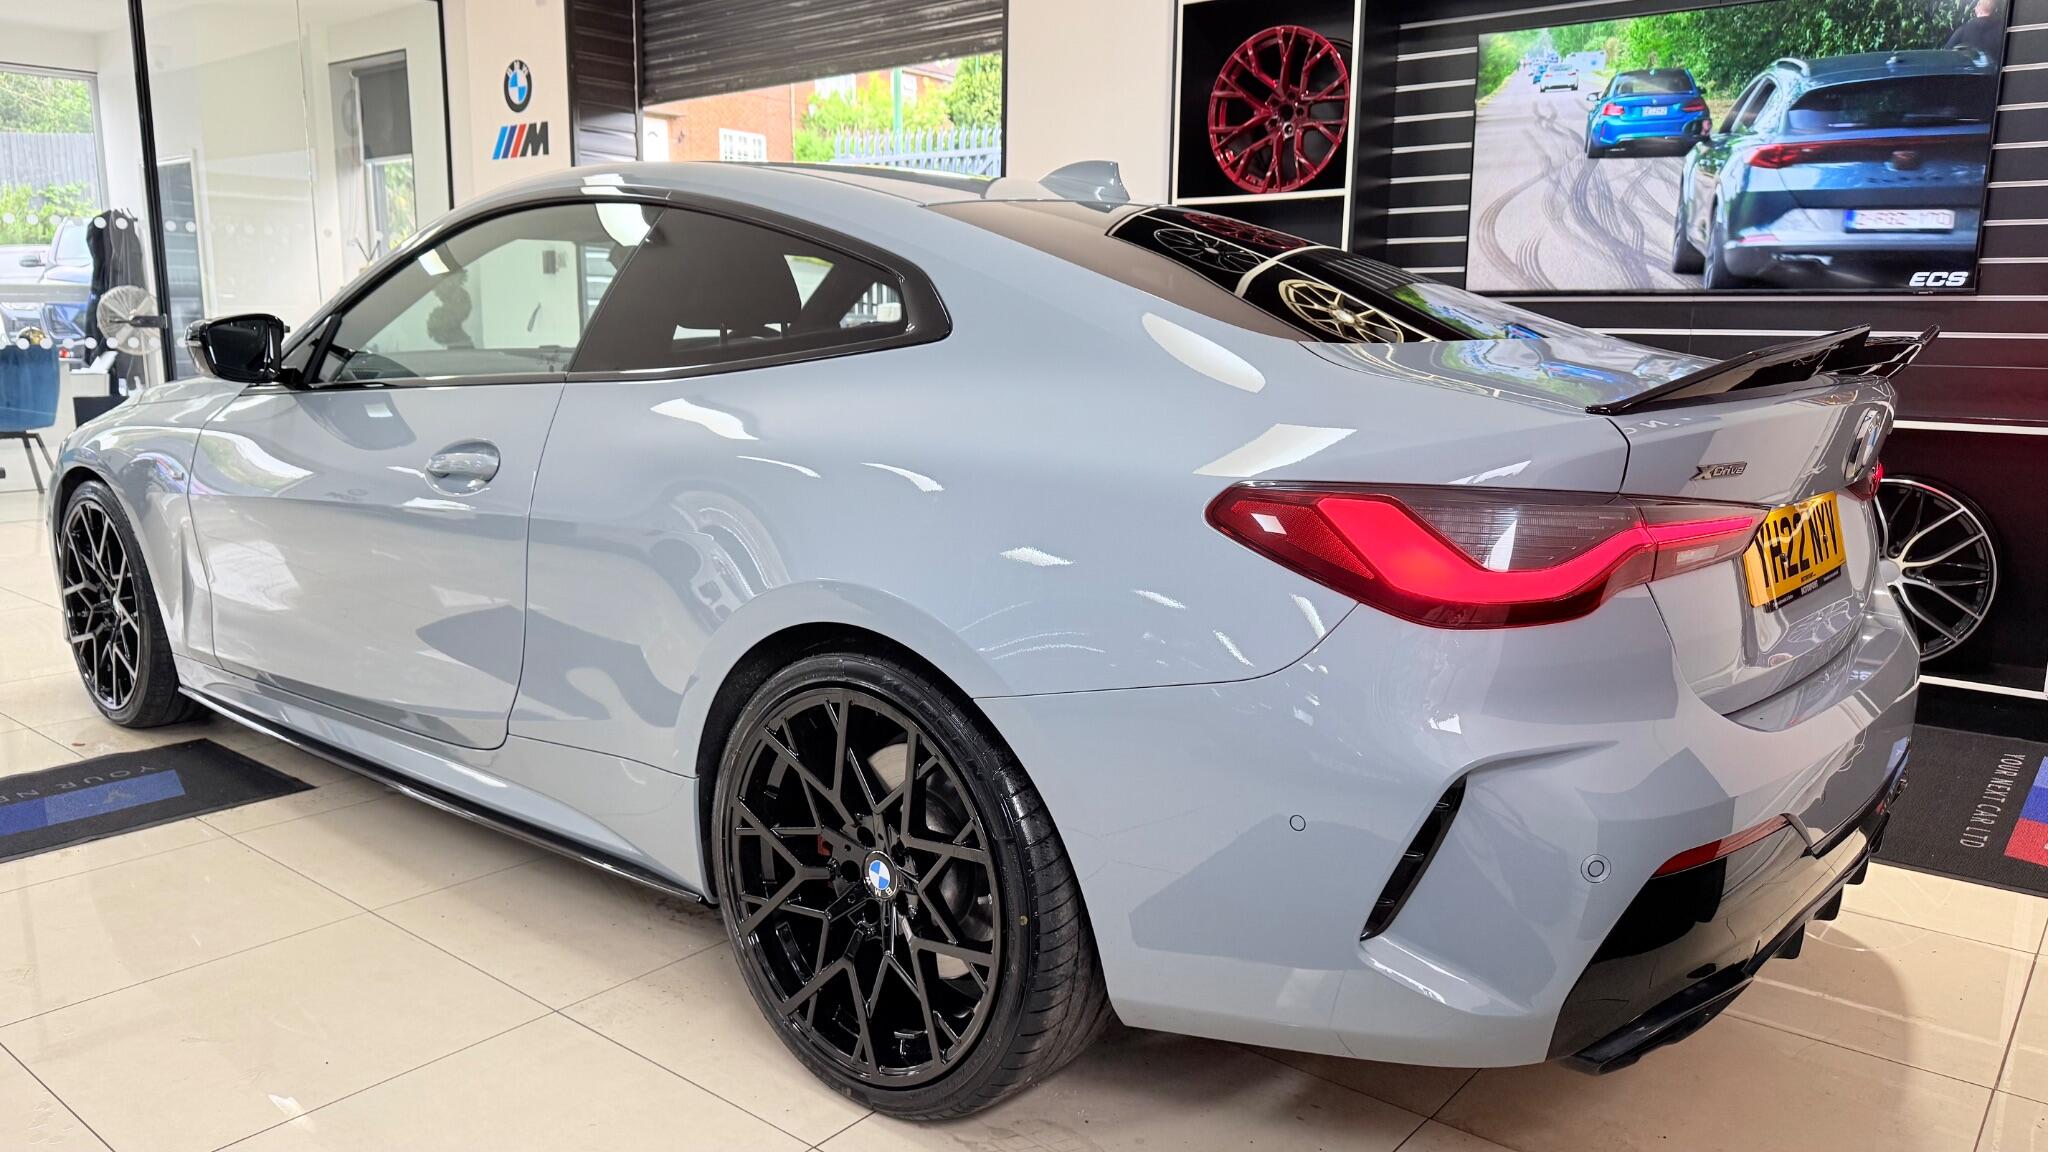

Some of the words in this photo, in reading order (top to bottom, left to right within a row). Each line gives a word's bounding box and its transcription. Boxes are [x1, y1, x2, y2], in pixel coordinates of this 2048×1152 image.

[1909, 271, 1969, 287] ECS
[1754, 512, 1811, 588] YH22
[1808, 500, 1838, 565] NYV
[56, 765, 156, 789] YOUR
[1994, 753, 2026, 777] YOUR
[1982, 777, 2014, 803] NEXT
[1970, 803, 2002, 825] CAR
[1960, 826, 1992, 848] LTD
